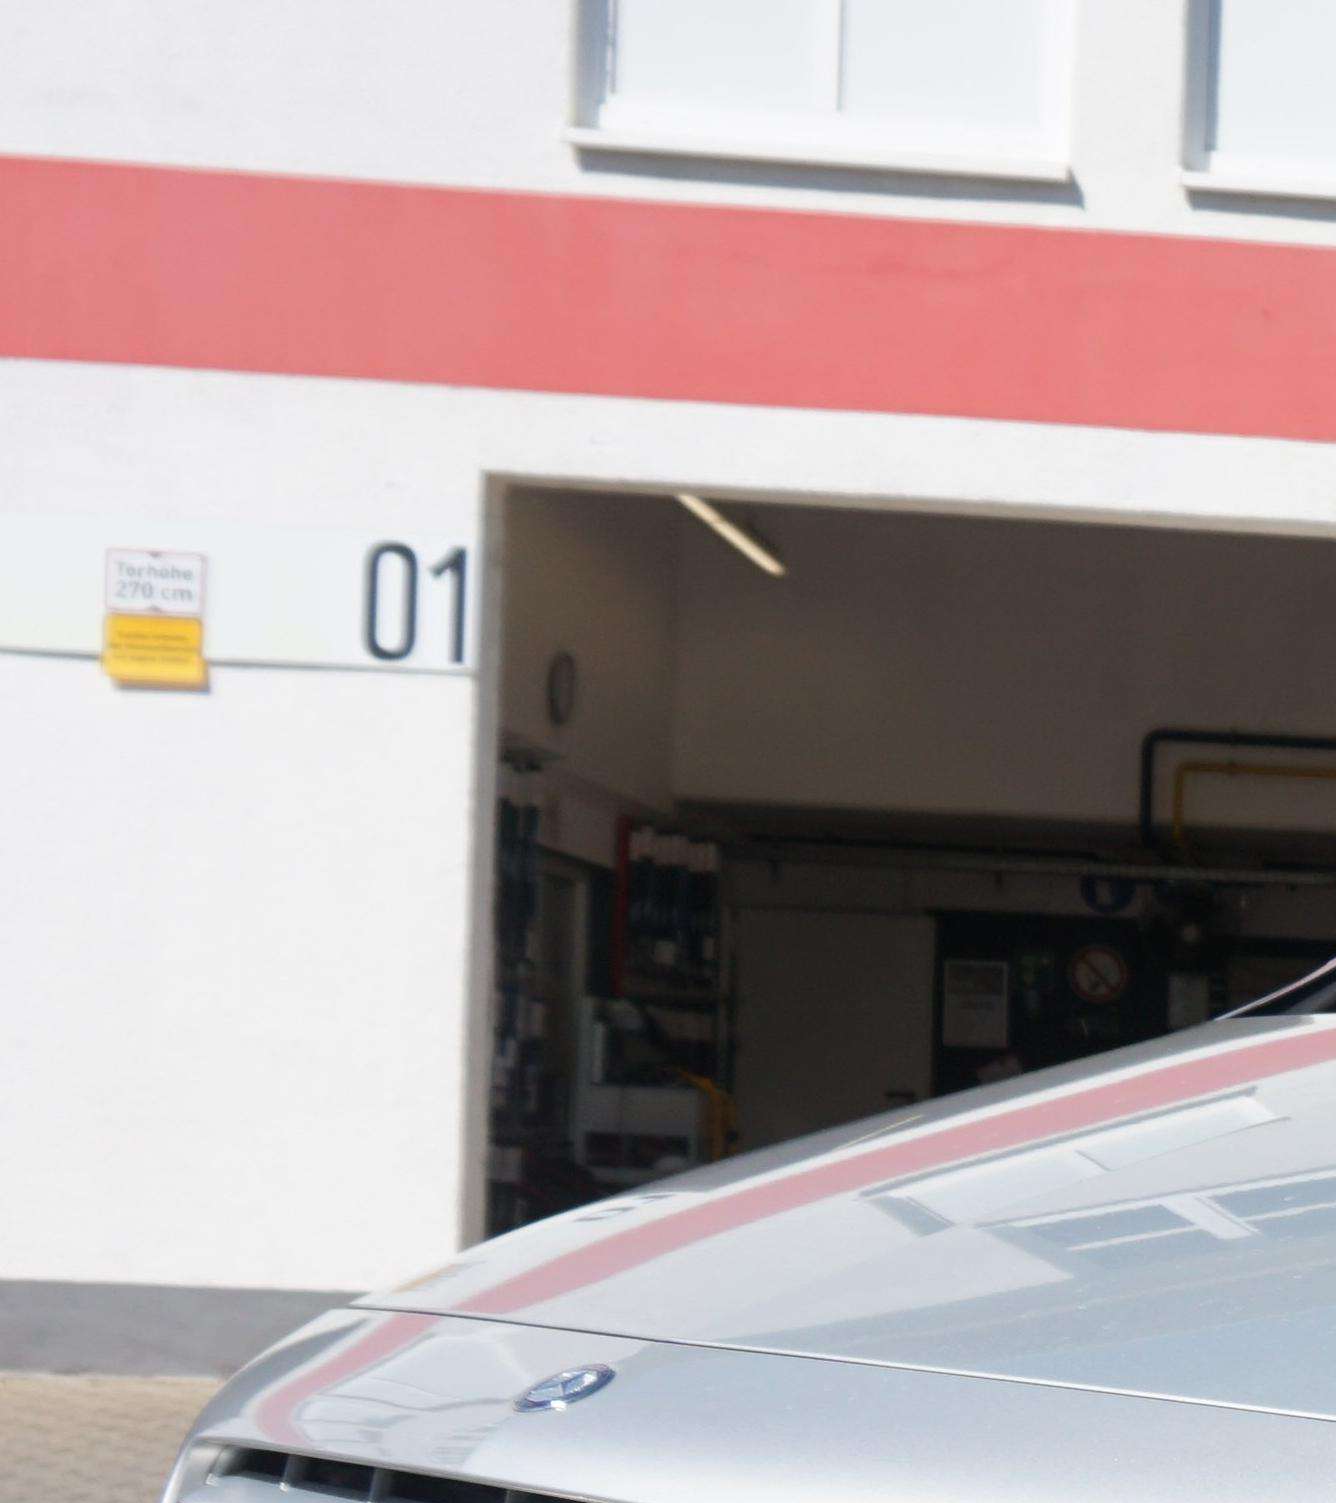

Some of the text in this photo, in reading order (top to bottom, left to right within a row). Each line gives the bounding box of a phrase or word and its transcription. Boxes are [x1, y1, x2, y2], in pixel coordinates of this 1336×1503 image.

[117, 579, 194, 602] 270 cm
[364, 541, 467, 662] 01
